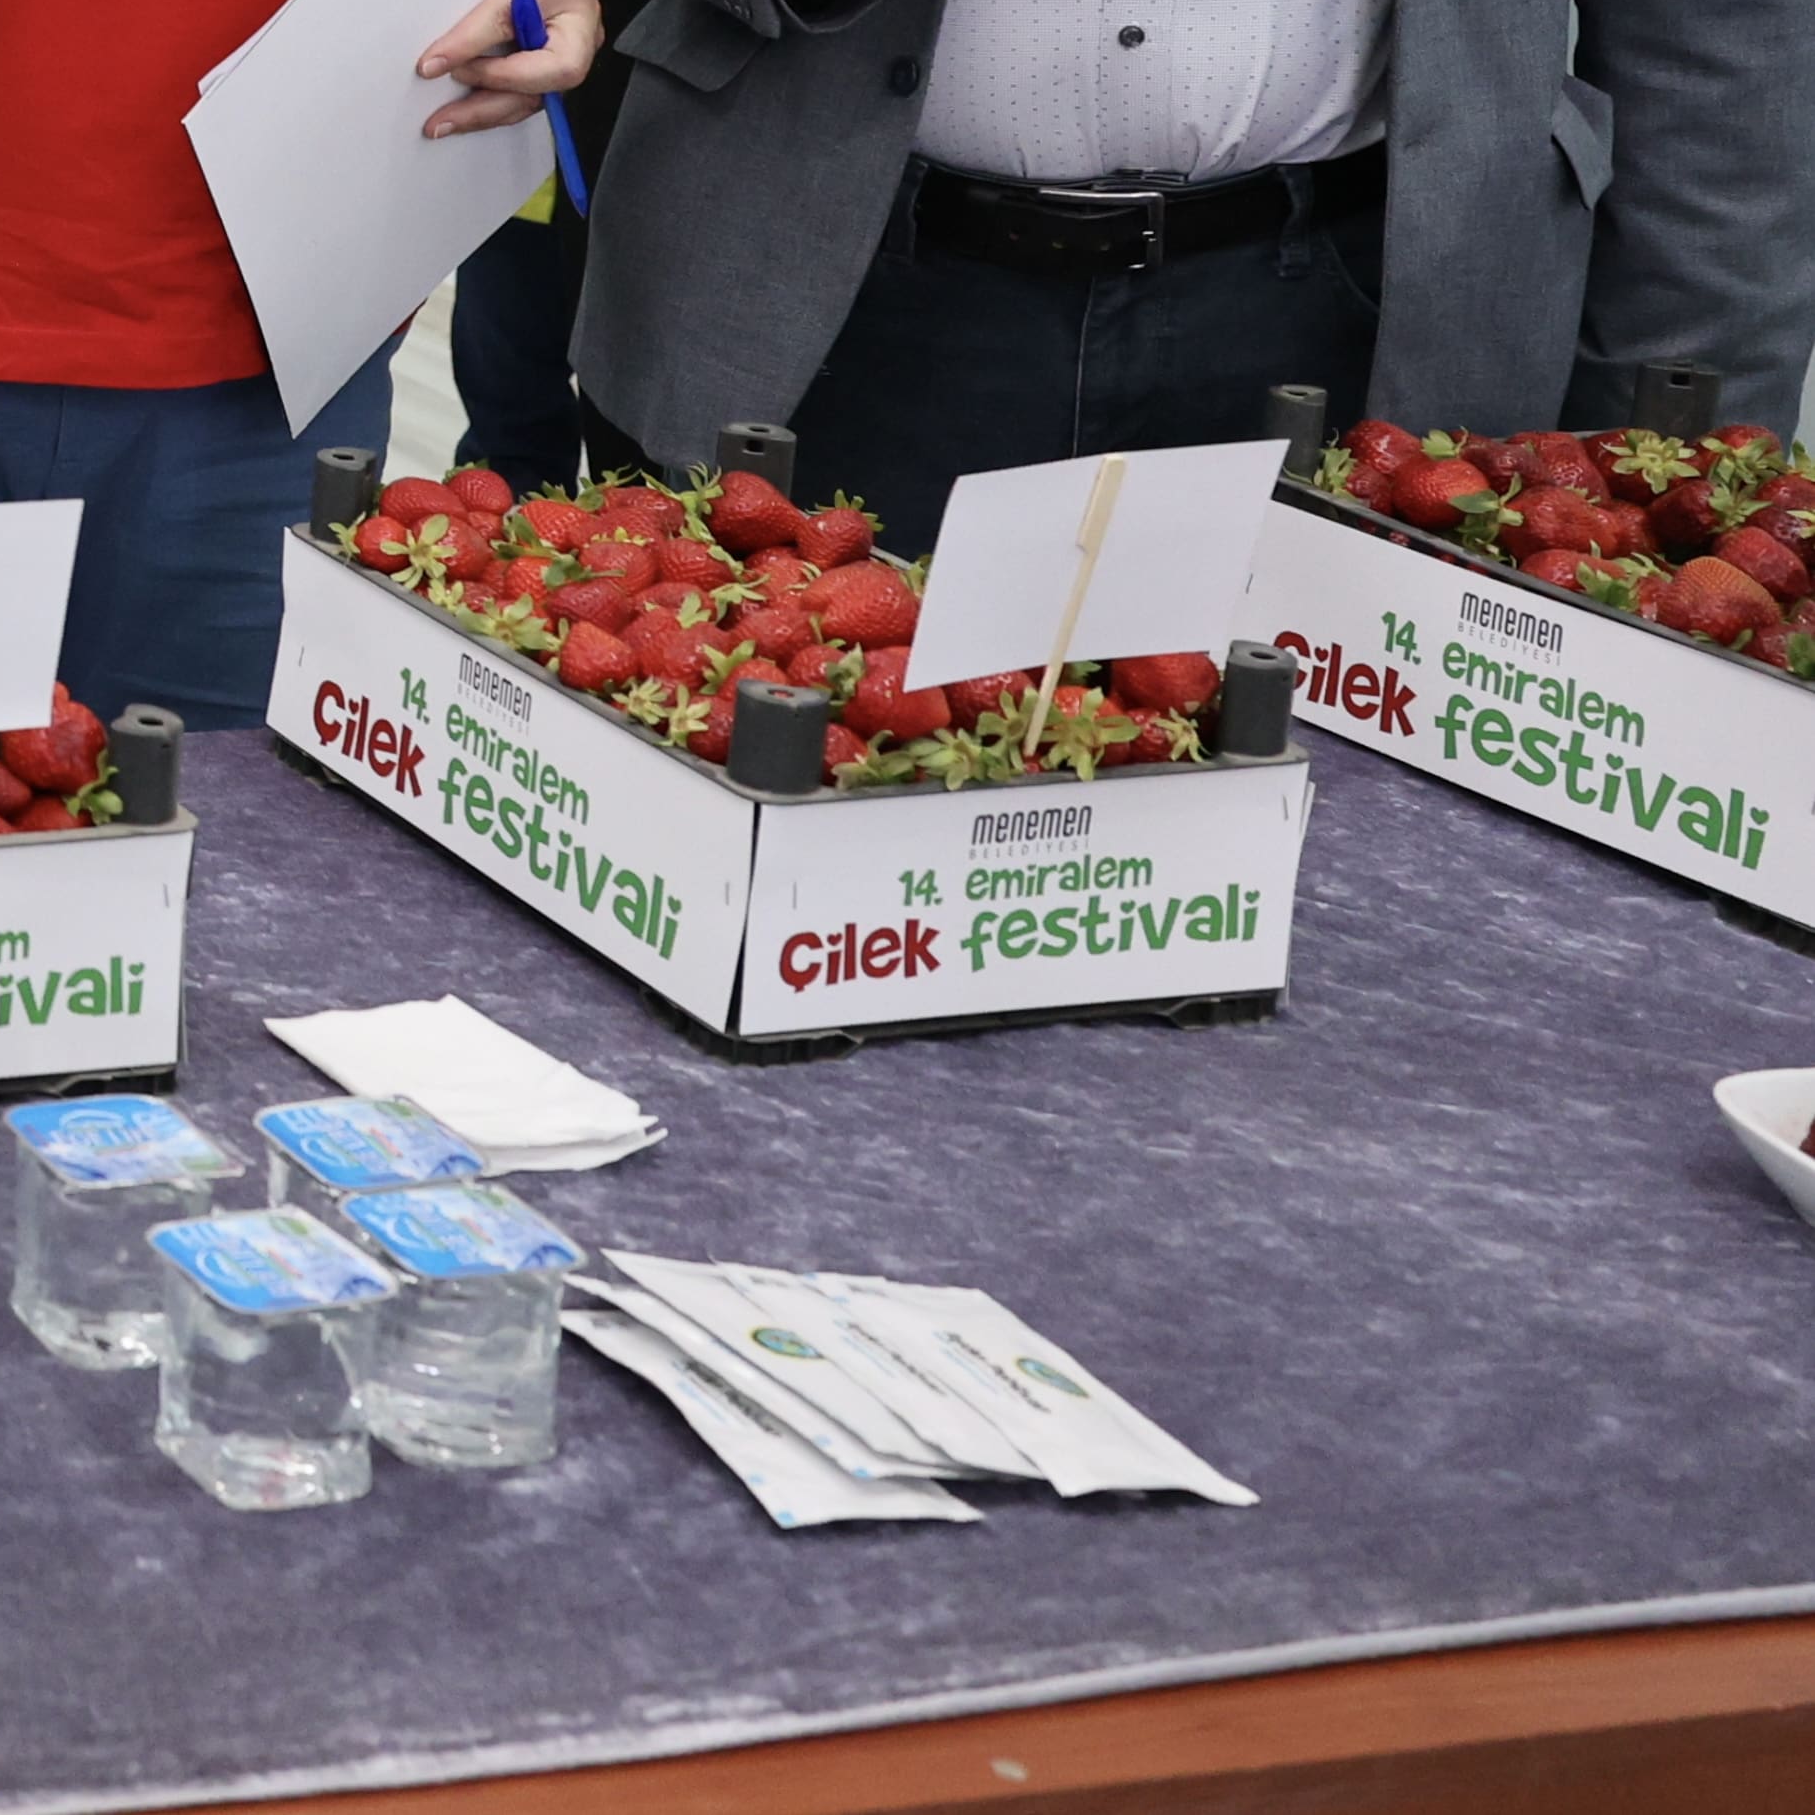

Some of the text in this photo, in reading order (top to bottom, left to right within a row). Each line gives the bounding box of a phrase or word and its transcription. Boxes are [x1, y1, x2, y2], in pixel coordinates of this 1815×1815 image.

[1459, 591, 1565, 655] menemen
[459, 651, 533, 723] menemen
[1381, 611, 1647, 748] 14. emiralem
[399, 667, 590, 826] 14. emiralem
[1434, 693, 1770, 870] festivali
[313, 679, 683, 961] Çilek festivali
[970, 804, 1093, 846] menemen
[898, 853, 1154, 907] 14. emiralem
[778, 883, 1261, 994] Çilek festivali
